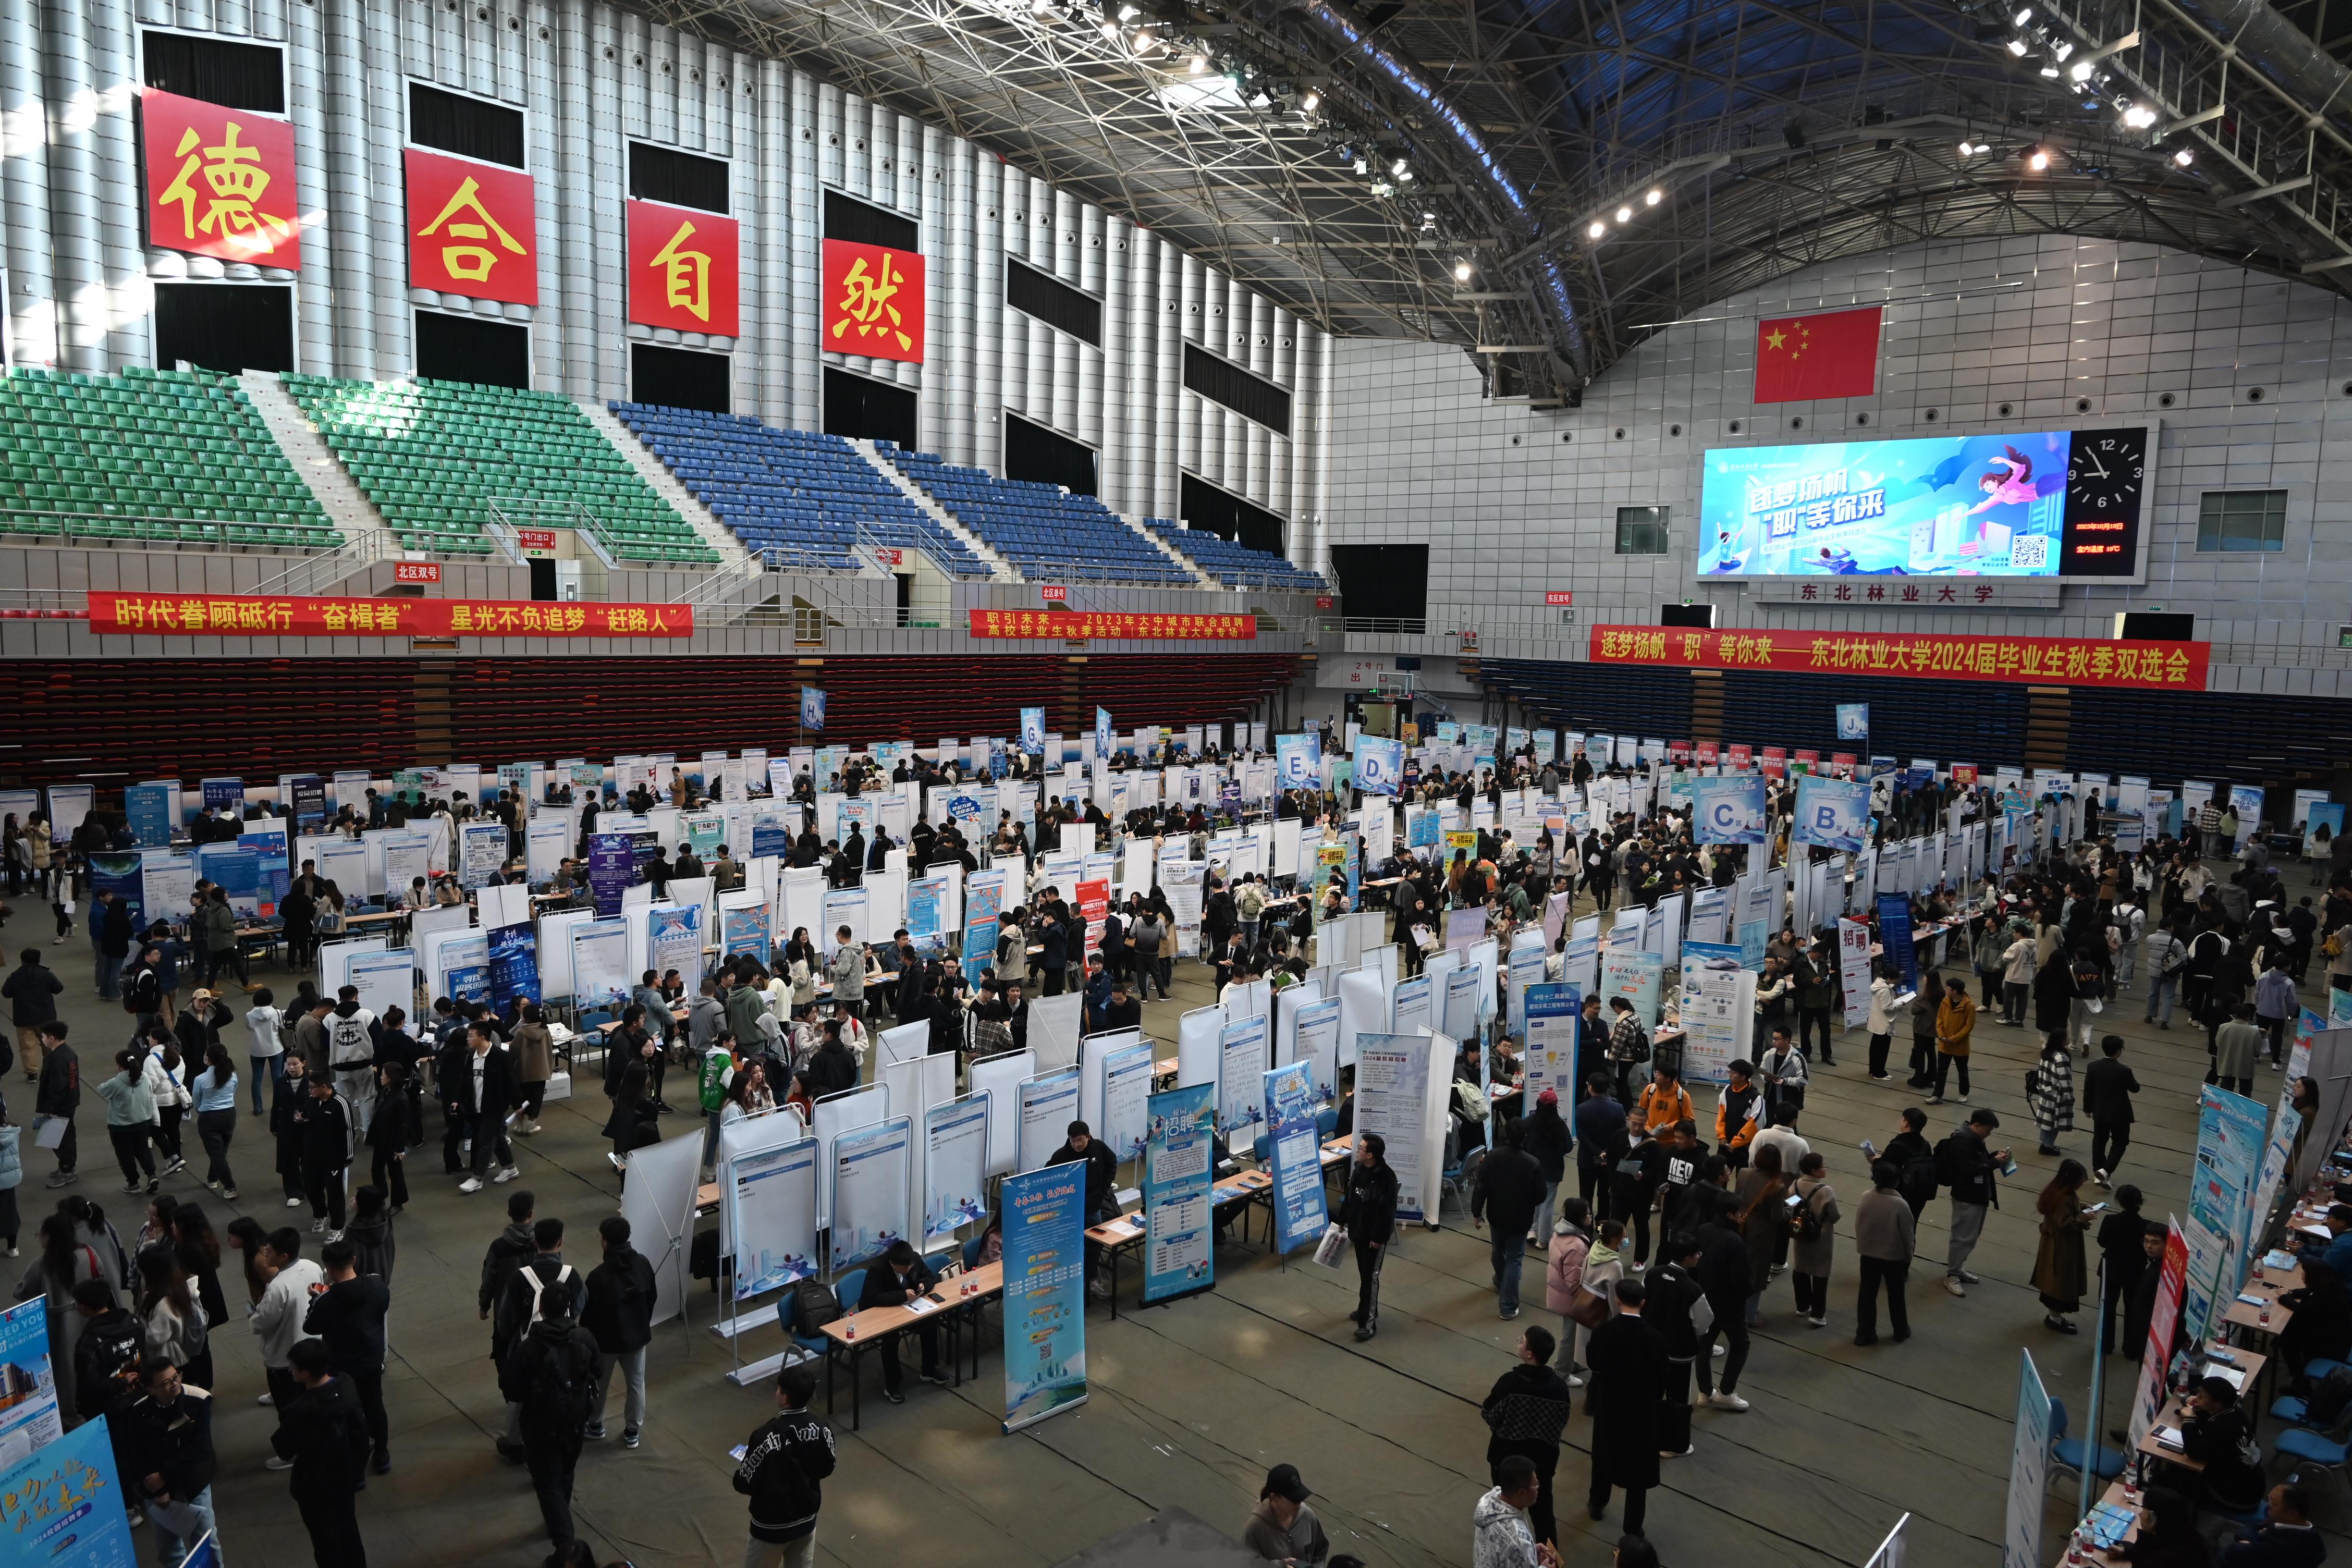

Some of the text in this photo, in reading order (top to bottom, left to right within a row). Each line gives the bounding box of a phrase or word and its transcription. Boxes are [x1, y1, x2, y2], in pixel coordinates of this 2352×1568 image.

[158, 121, 289, 254] 德
[417, 176, 527, 282] 合
[649, 220, 711, 322] 自
[832, 252, 912, 352] 然
[2100, 439, 2115, 450] 12
[2067, 467, 2143, 480] 9 3
[1750, 468, 1848, 513] 逐梦扬帆
[2098, 497, 2107, 508] 6
[520, 533, 549, 541] 7号门出口
[398, 565, 437, 579] 北区双号
[1044, 588, 1064, 599] 北区单号
[1547, 593, 1570, 604] 东区双号
[1801, 583, 1993, 603] 东北林业大学
[1356, 662, 1383, 670] 2号门
[1351, 672, 1387, 683] 出口
[1290, 756, 1307, 775] E区
[1366, 758, 1383, 779] D区
[1956, 769, 1974, 778] 聘
[297, 789, 323, 798] 校园招聘
[1714, 804, 1742, 827] C区
[1816, 805, 1843, 831] B区
[1843, 929, 1867, 953] 招聘
[455, 979, 491, 993] 极客的你
[463, 974, 482, 984] 寻找
[1534, 992, 1571, 1001] 中铁十二局集团
[1529, 1001, 1575, 1010] 建筑安装工程有限公司
[1173, 1107, 1187, 1116] 校园
[1163, 1111, 1204, 1136] 招聘
[22, 1312, 43, 1329] YOU
[8, 1322, 45, 1343] RECRUITMENT
[30, 1509, 84, 1548] 2024校园招聘季
